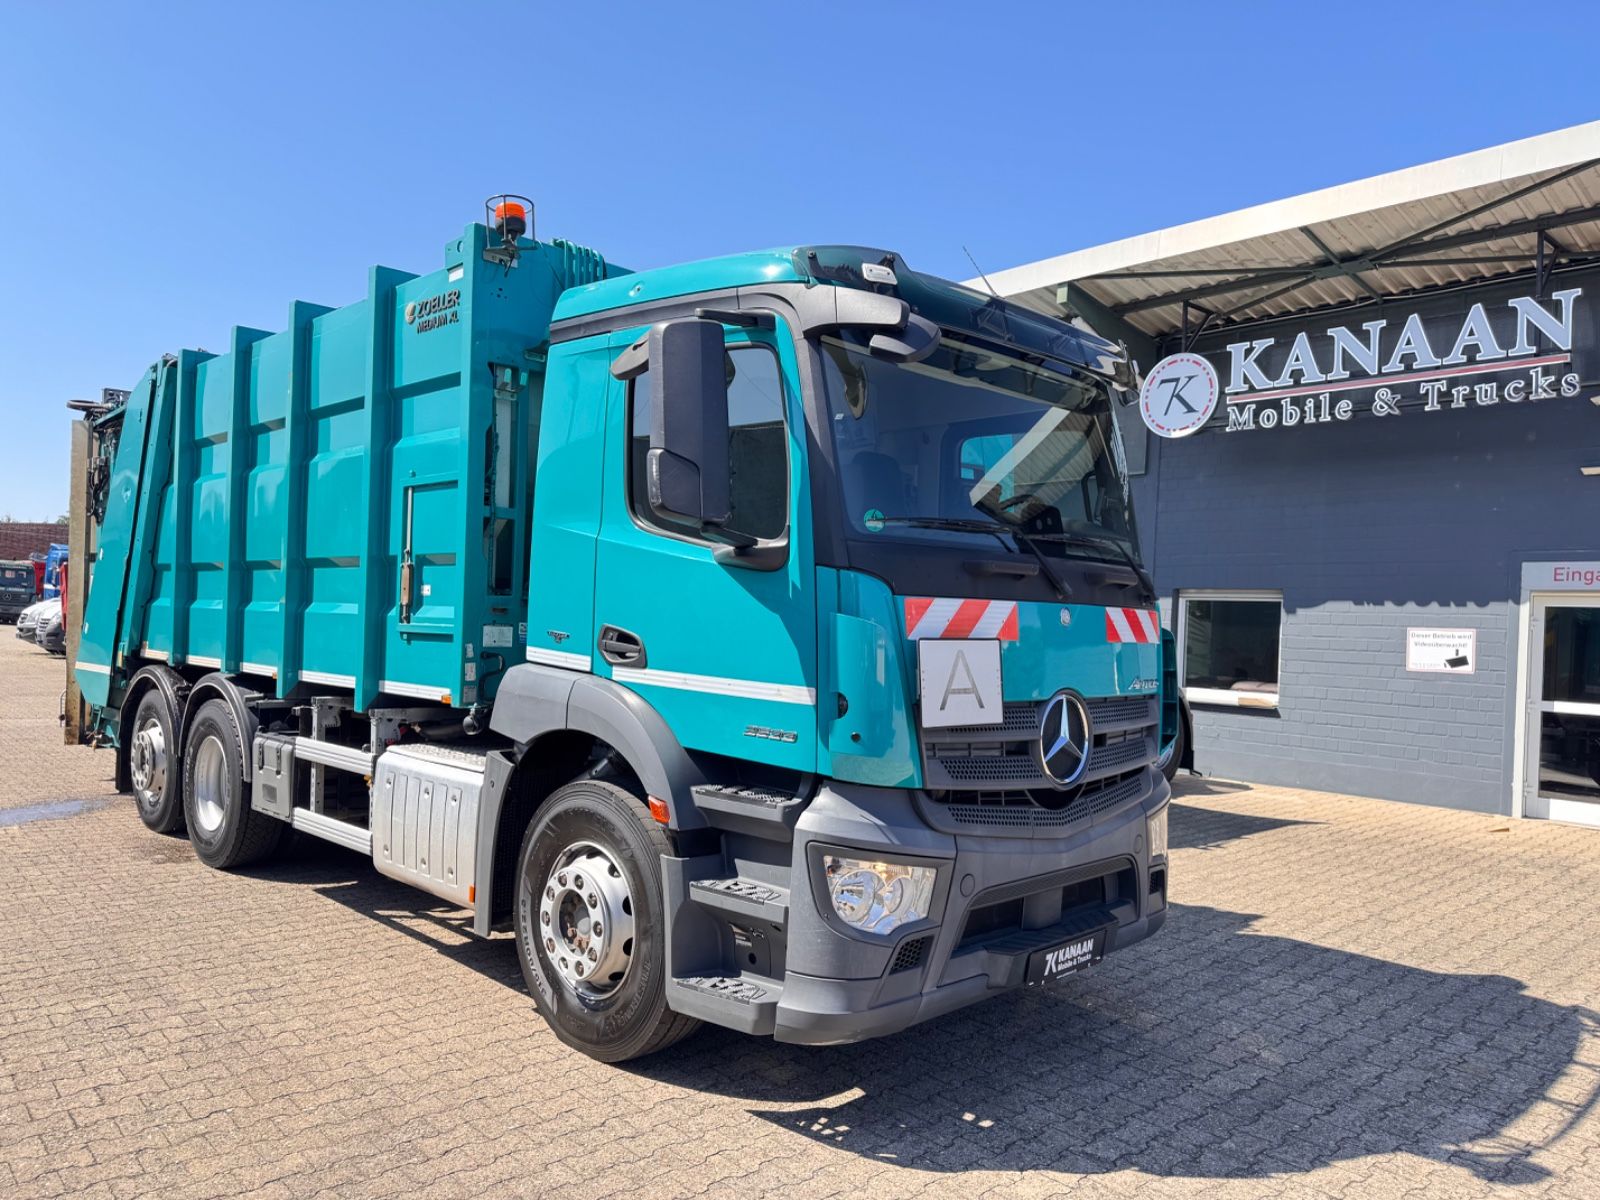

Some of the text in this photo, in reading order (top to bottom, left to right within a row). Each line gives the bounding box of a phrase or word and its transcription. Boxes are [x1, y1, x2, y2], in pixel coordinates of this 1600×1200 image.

[417, 289, 461, 319] ZOELLER
[1225, 287, 1582, 393] KANAAN
[1226, 368, 1581, 432] Mobile & Trucks
[940, 650, 985, 710] A
[1058, 938, 1094, 963] KANAAN
